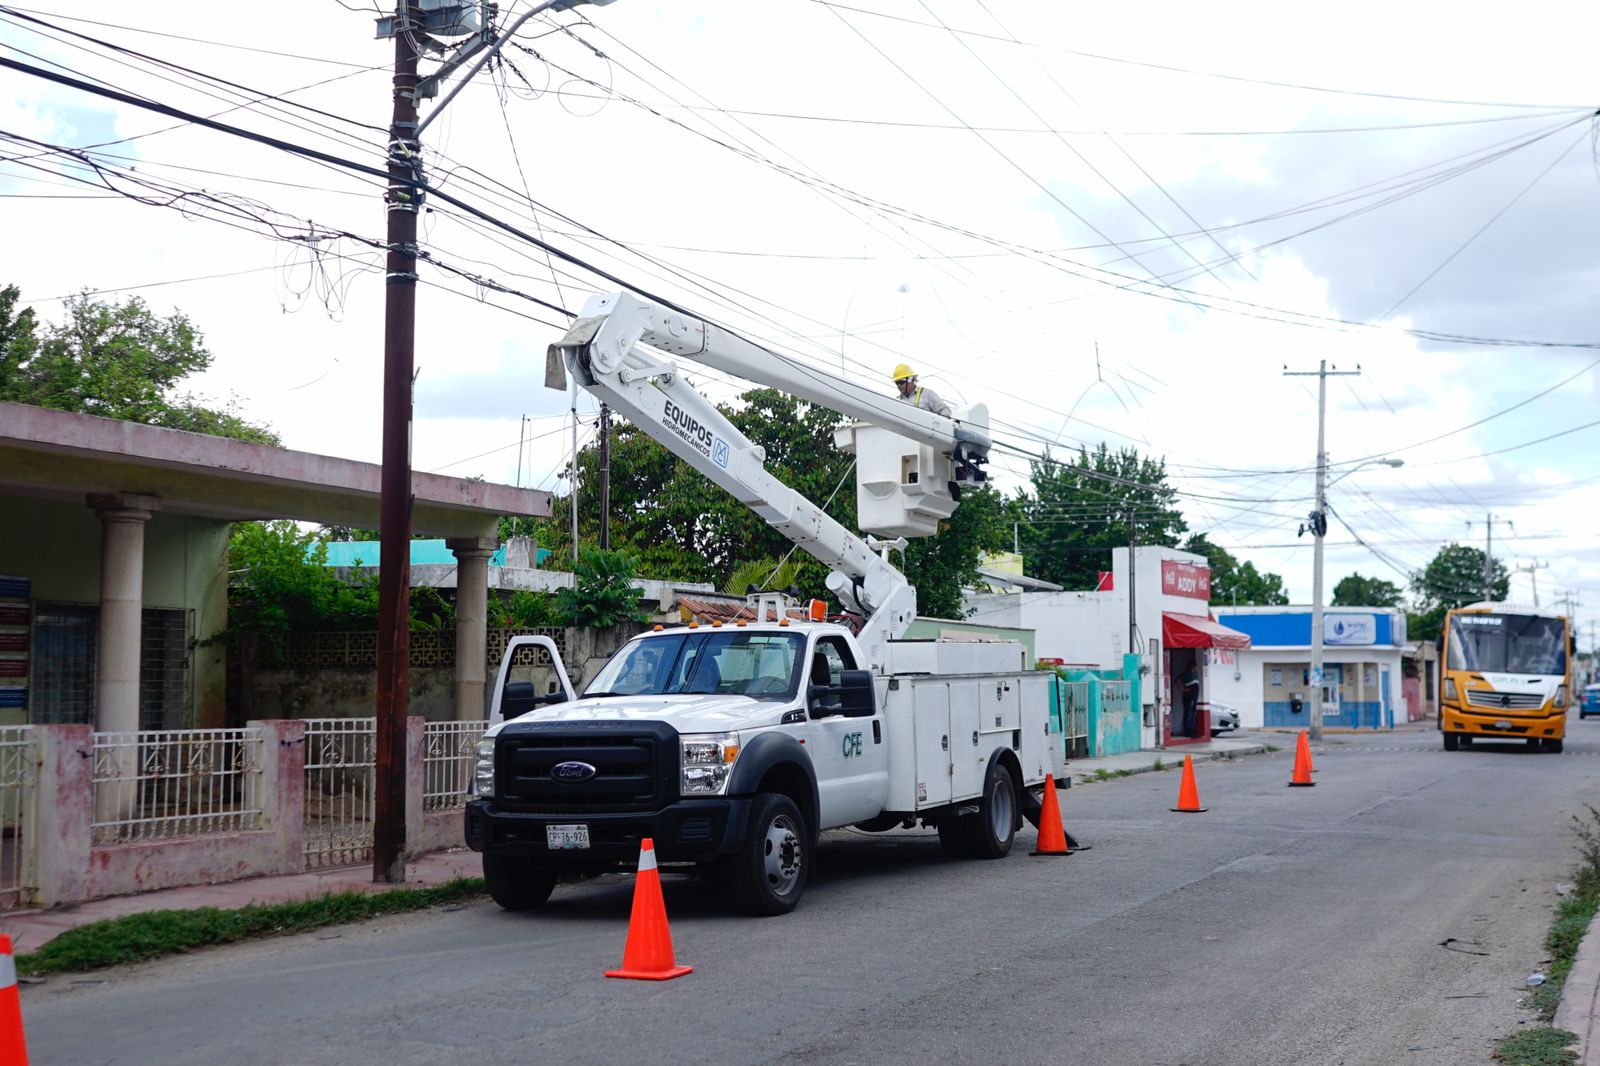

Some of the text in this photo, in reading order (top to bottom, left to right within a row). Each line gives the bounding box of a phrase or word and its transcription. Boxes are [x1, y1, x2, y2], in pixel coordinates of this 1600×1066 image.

[664, 400, 713, 447] EQUIPOS
[1178, 577, 1197, 593] ADDY
[842, 732, 863, 759] CFE
